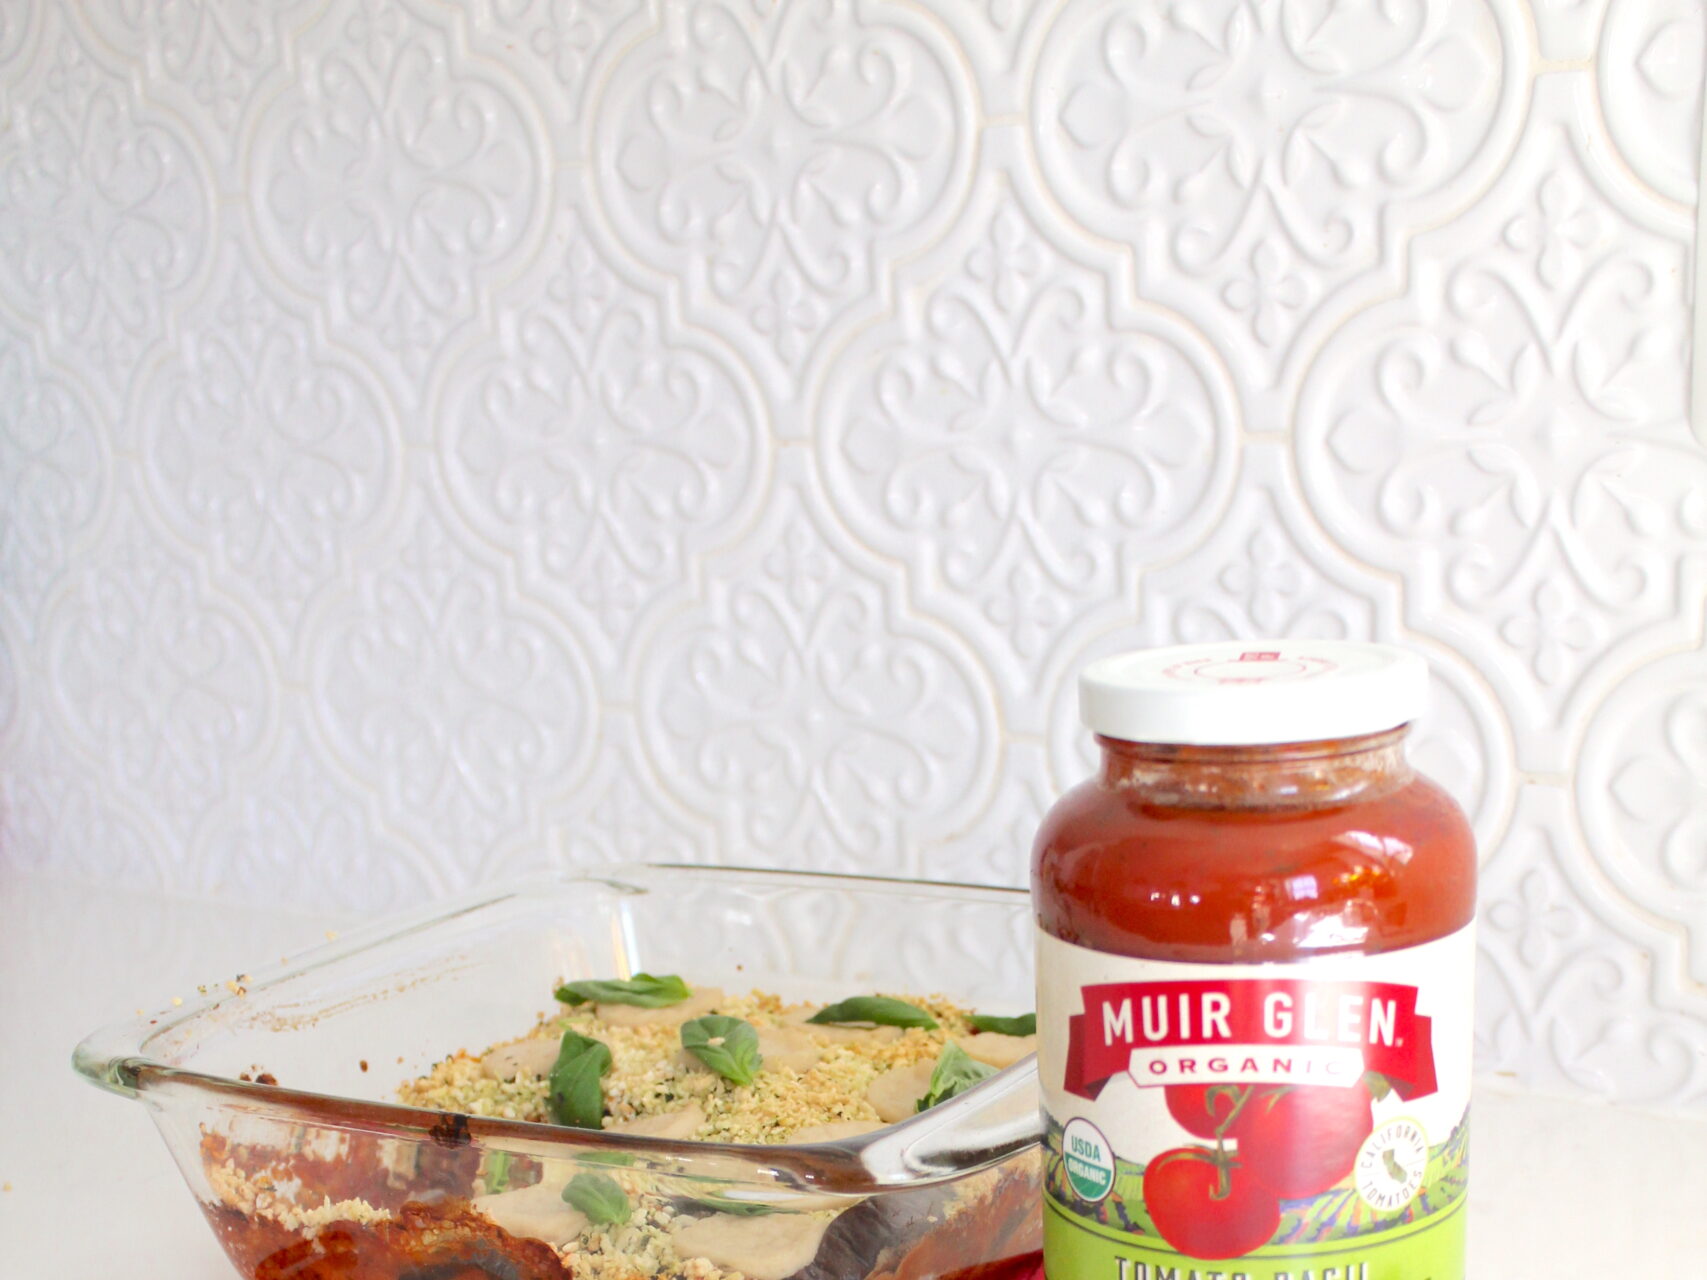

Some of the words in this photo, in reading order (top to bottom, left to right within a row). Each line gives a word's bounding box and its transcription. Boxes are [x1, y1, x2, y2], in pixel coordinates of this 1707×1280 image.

[1102, 992, 1232, 1047] MUIR
[1263, 991, 1397, 1047] GLEN
[1149, 1057, 1344, 1075] ORGANIC
[1071, 1135, 1101, 1162] USDA
[1360, 1124, 1425, 1169] CALIFORNIA
[1067, 1157, 1107, 1187] ORGANIC
[1361, 1170, 1423, 1208] TOMATOES
